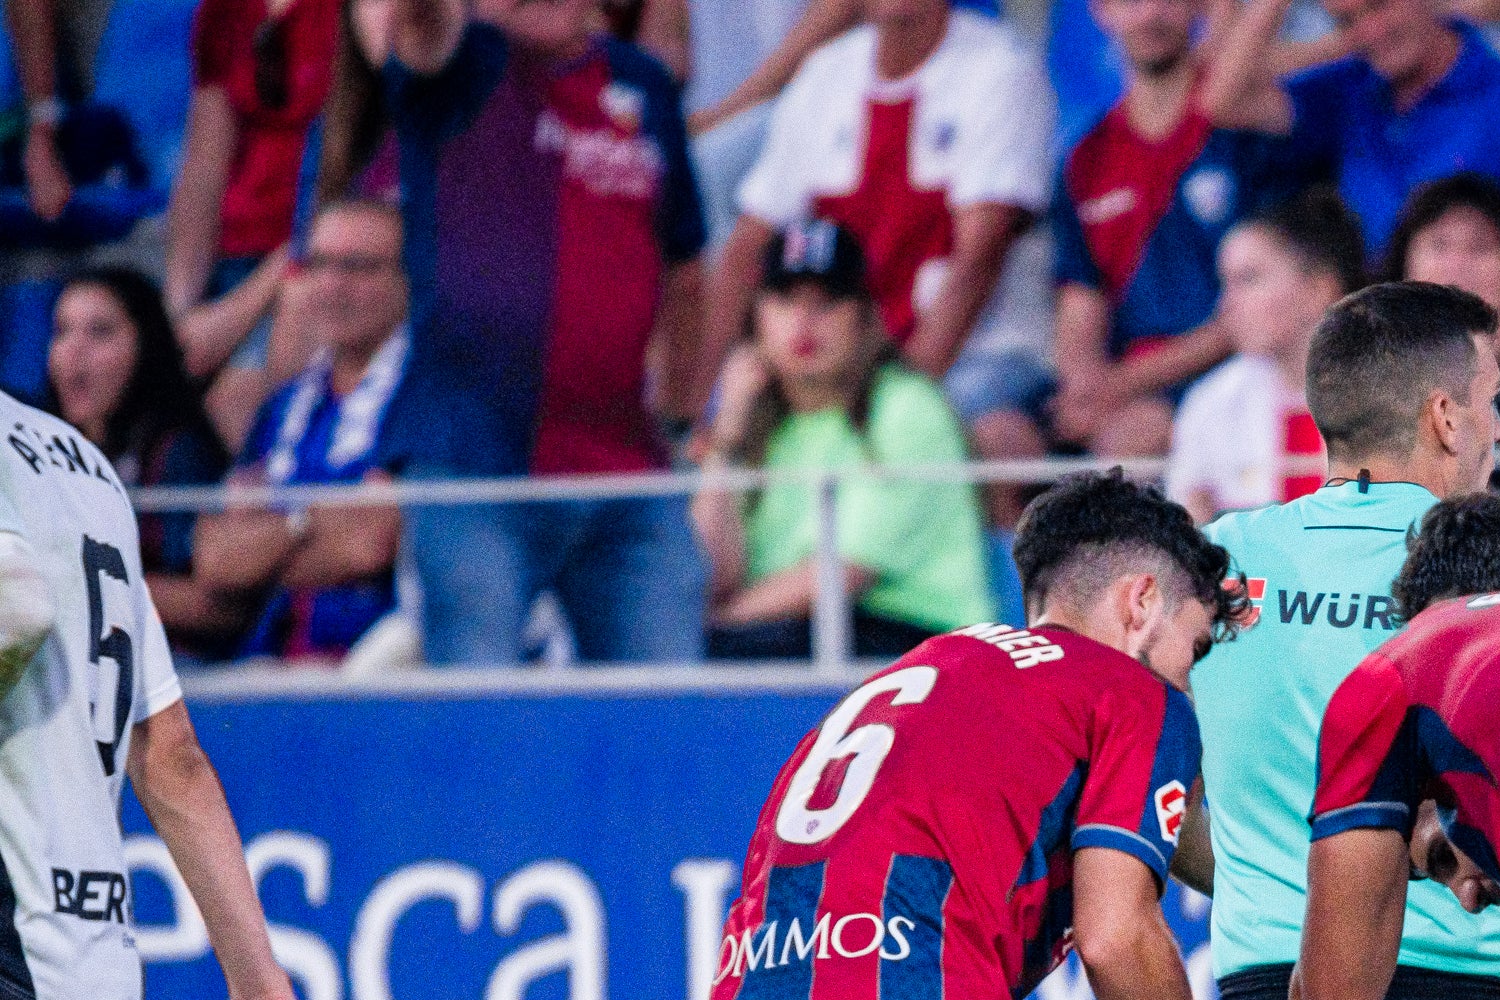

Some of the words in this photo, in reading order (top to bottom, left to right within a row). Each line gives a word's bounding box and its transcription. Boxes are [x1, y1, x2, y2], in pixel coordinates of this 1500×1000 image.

[83, 533, 133, 777] 5
[1278, 589, 1394, 630] WÜR
[776, 665, 938, 845] 6
[712, 912, 916, 986] OMMOS
